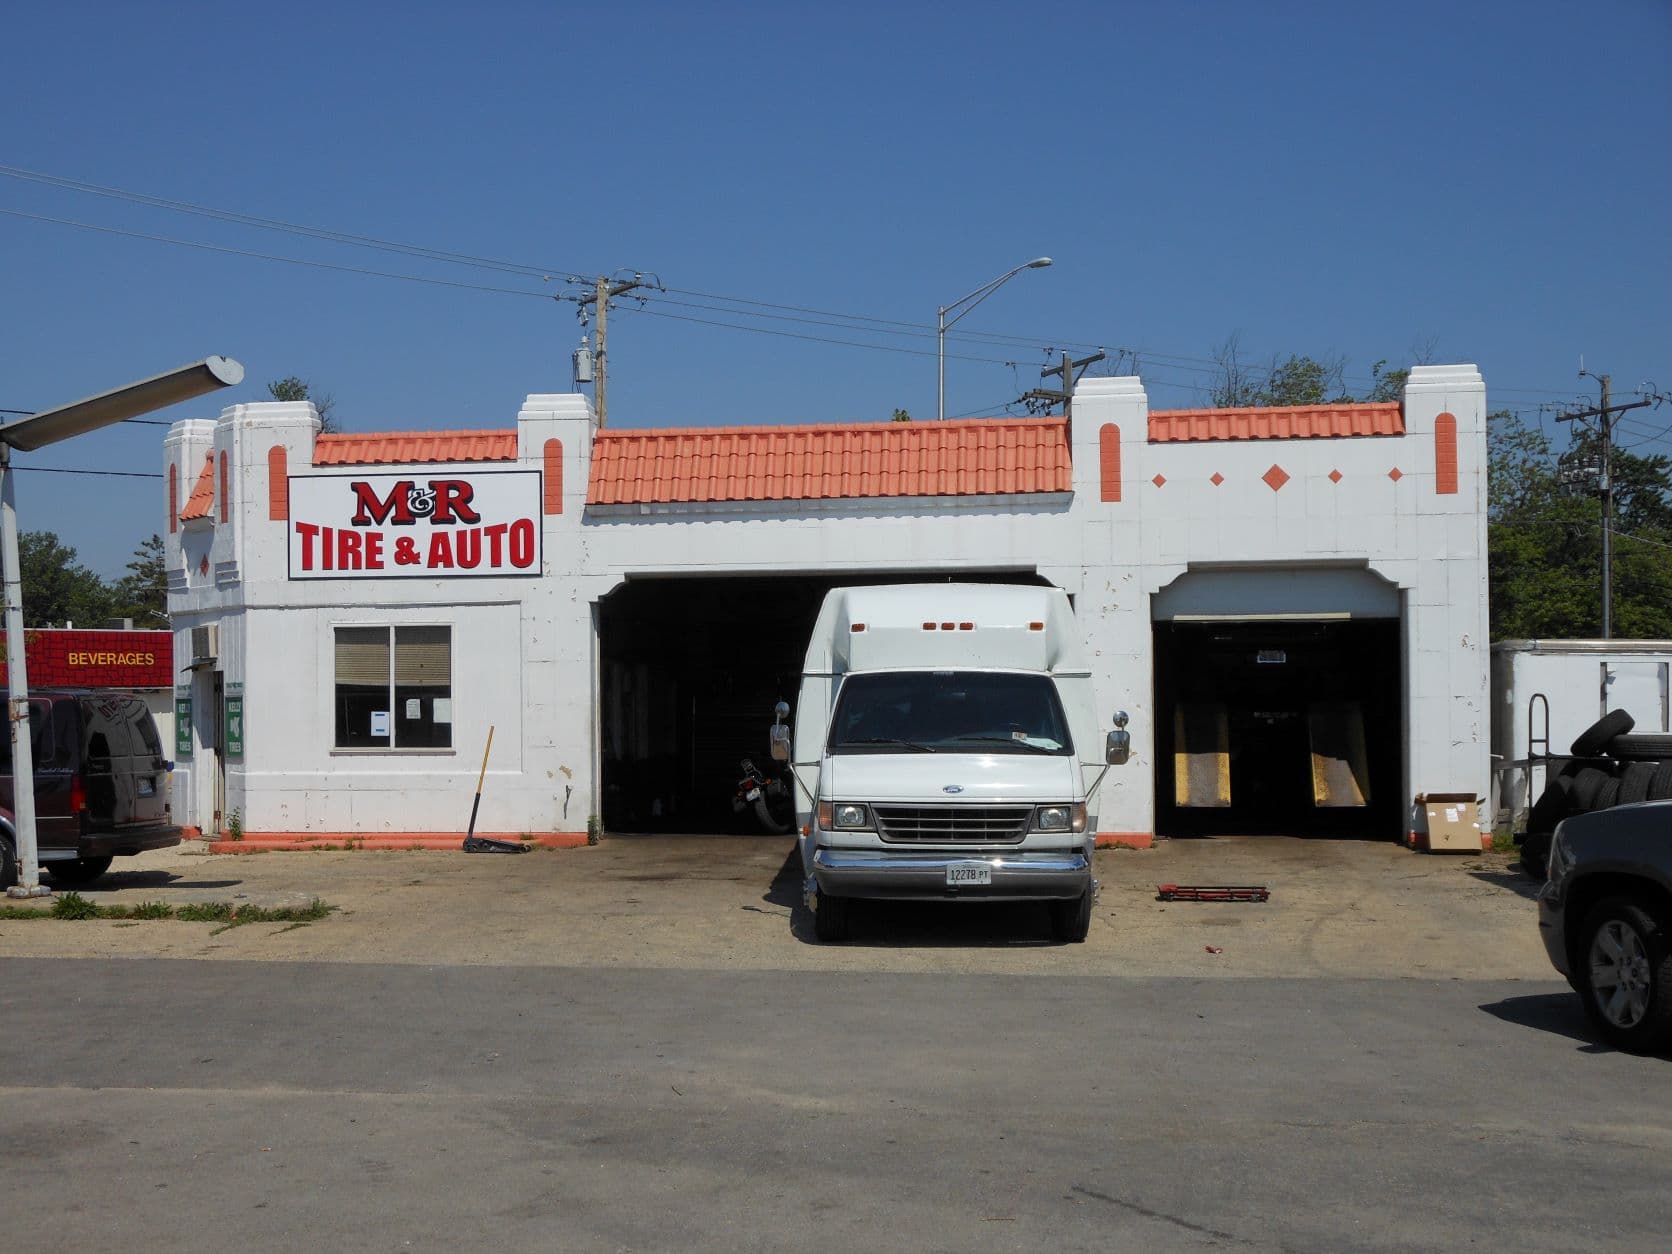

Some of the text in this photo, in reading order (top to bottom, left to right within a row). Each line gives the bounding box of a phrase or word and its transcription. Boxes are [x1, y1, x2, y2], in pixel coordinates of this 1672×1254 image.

[351, 480, 481, 526] M&R
[296, 518, 535, 571] TIRE & AUTO
[68, 652, 155, 666] BEVERAGES
